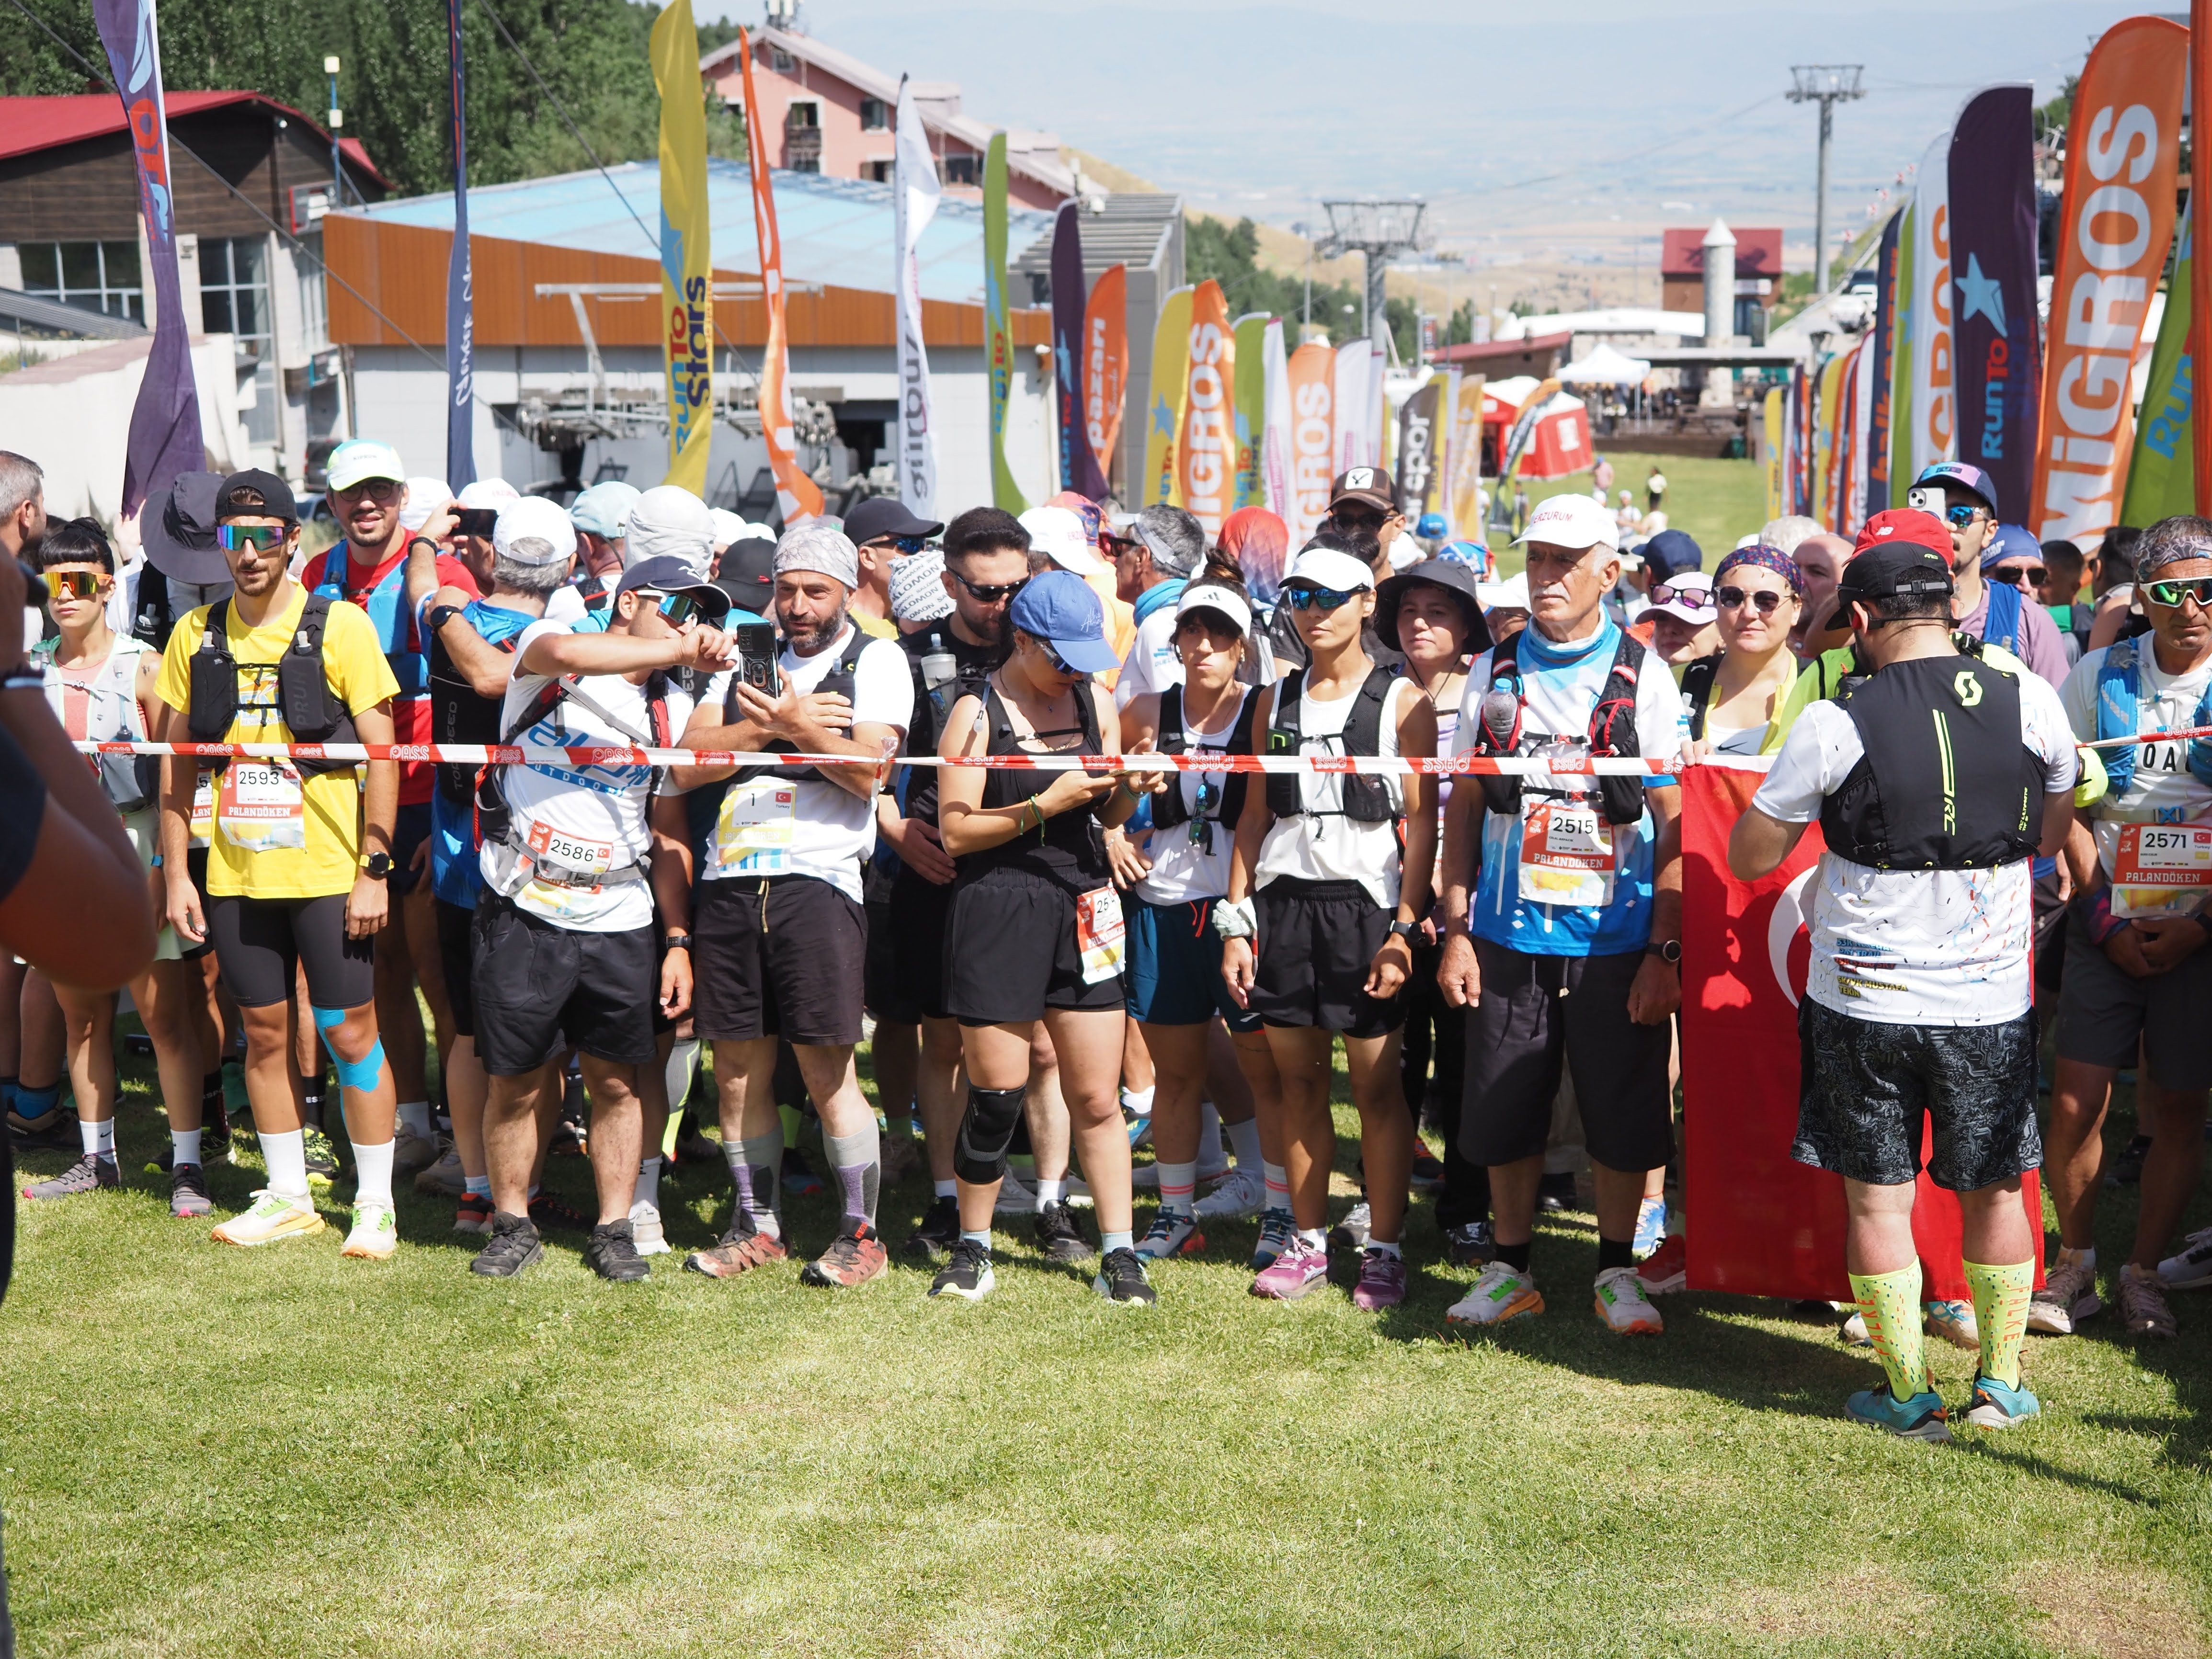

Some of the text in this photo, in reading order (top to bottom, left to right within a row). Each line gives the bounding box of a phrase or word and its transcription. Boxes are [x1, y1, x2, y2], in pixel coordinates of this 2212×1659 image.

[685, 276, 710, 407] Stars
[1981, 338, 2008, 459] RunTo
[1533, 511, 1573, 524] ERZURUM
[898, 587, 939, 616] SALOMON
[389, 745, 430, 761] PASS
[493, 749, 521, 761] PASS
[592, 748, 634, 763] PASS
[1188, 755, 1234, 770] PASS
[1315, 756, 1347, 769] PASS
[1422, 757, 1471, 773] PASS
[1552, 758, 1585, 771] PASS
[239, 771, 279, 785] 2593
[751, 793, 755, 807] 1
[228, 806, 291, 817] PALANDÖKEN
[1944, 797, 1956, 836] RC
[1553, 817, 1593, 834] 2515
[2144, 833, 2187, 849] 2571
[550, 839, 595, 862] 2586
[1533, 852, 1604, 868] PALANDÖKEN
[2125, 871, 2201, 883] PALANDÖKEN
[1864, 980, 1908, 991] MUSTAFA
[2003, 1285, 2030, 1342] FALKE
[1857, 1297, 1890, 1356] FALKE
